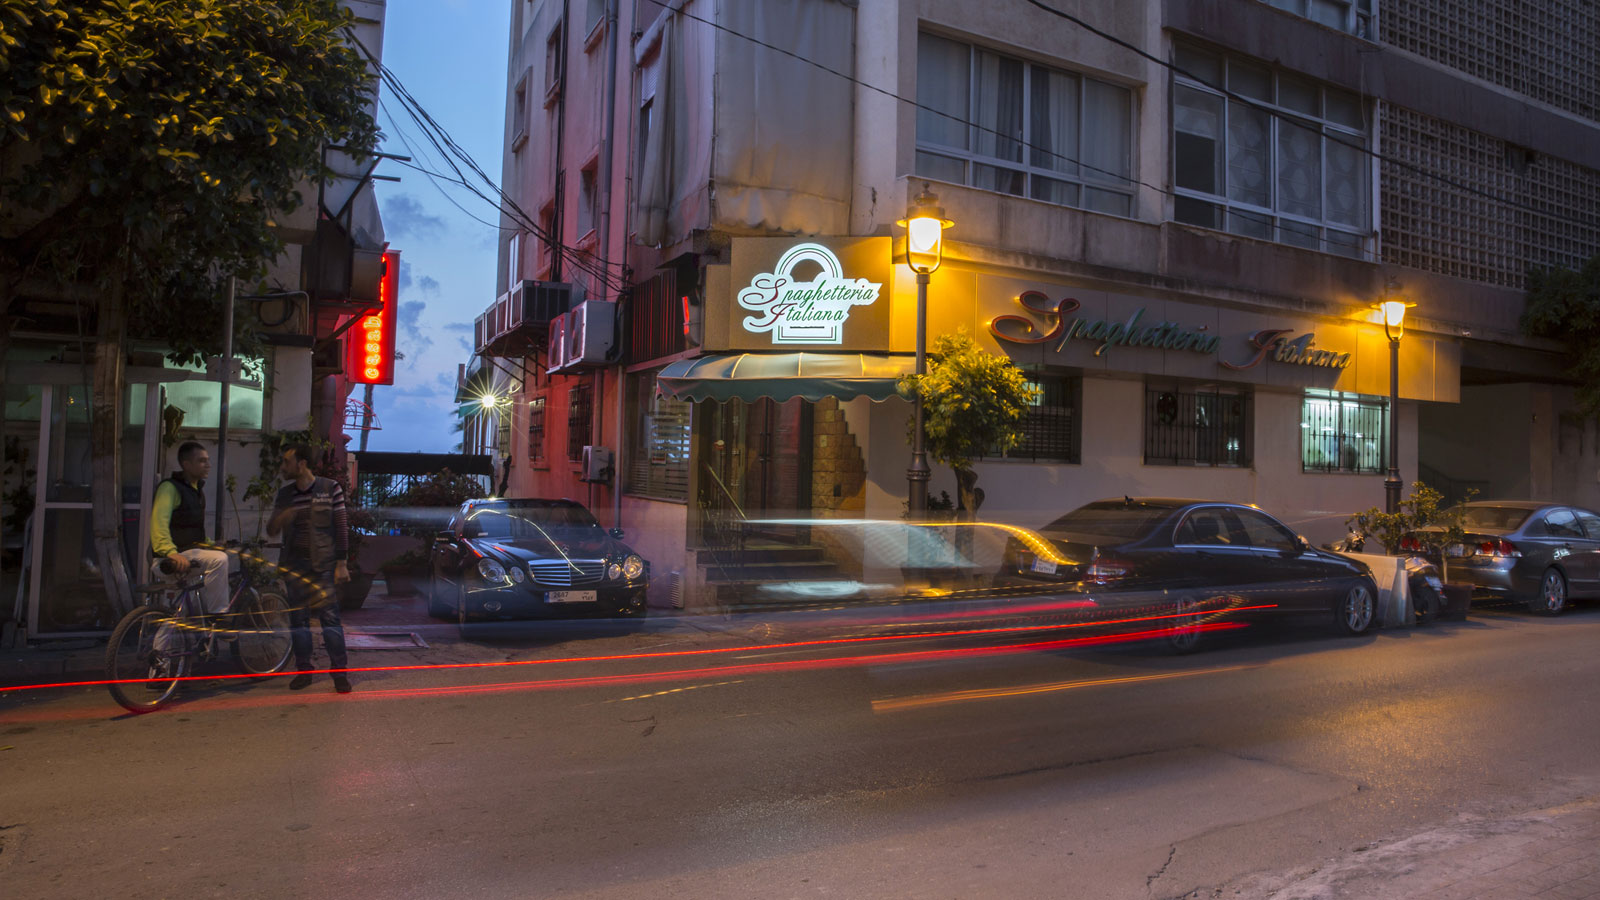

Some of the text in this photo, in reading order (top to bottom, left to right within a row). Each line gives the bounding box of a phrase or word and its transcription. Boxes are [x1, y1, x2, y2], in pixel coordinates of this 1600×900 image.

[742, 278, 874, 308] Spaghetteria
[749, 301, 845, 328] Italiana
[990, 290, 1353, 370] Spaghetteria Italiana
